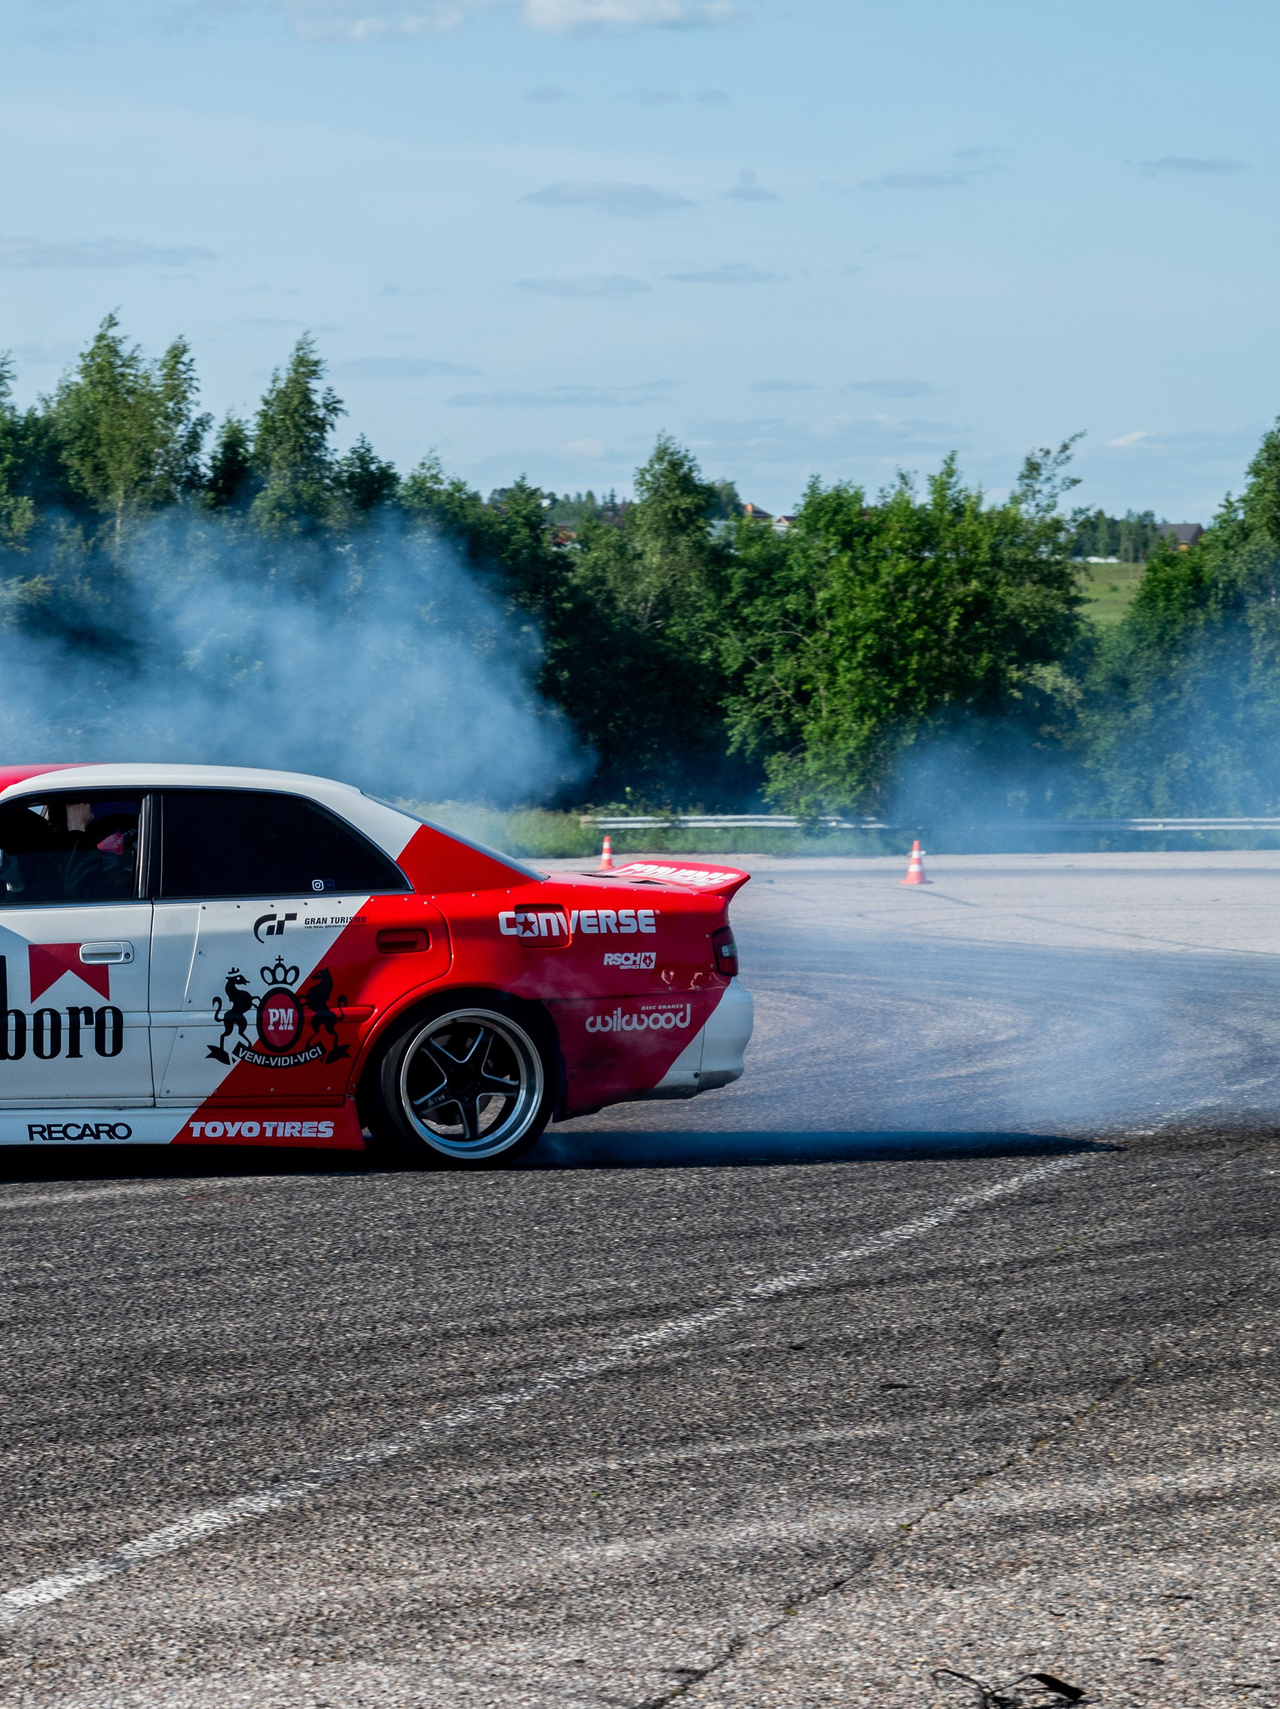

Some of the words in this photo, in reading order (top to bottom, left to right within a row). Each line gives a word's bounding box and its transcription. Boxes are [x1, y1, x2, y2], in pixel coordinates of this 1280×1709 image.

[304, 917, 327, 925] GRAN
[330, 916, 367, 924] TURISMO
[498, 909, 656, 936] CONVERSE
[603, 953, 641, 965] RSCH
[267, 1008, 294, 1031] PM
[585, 1004, 691, 1033] wilwood
[238, 1046, 322, 1067] VENI-VIDI-VICI
[27, 1122, 132, 1141] RECARO
